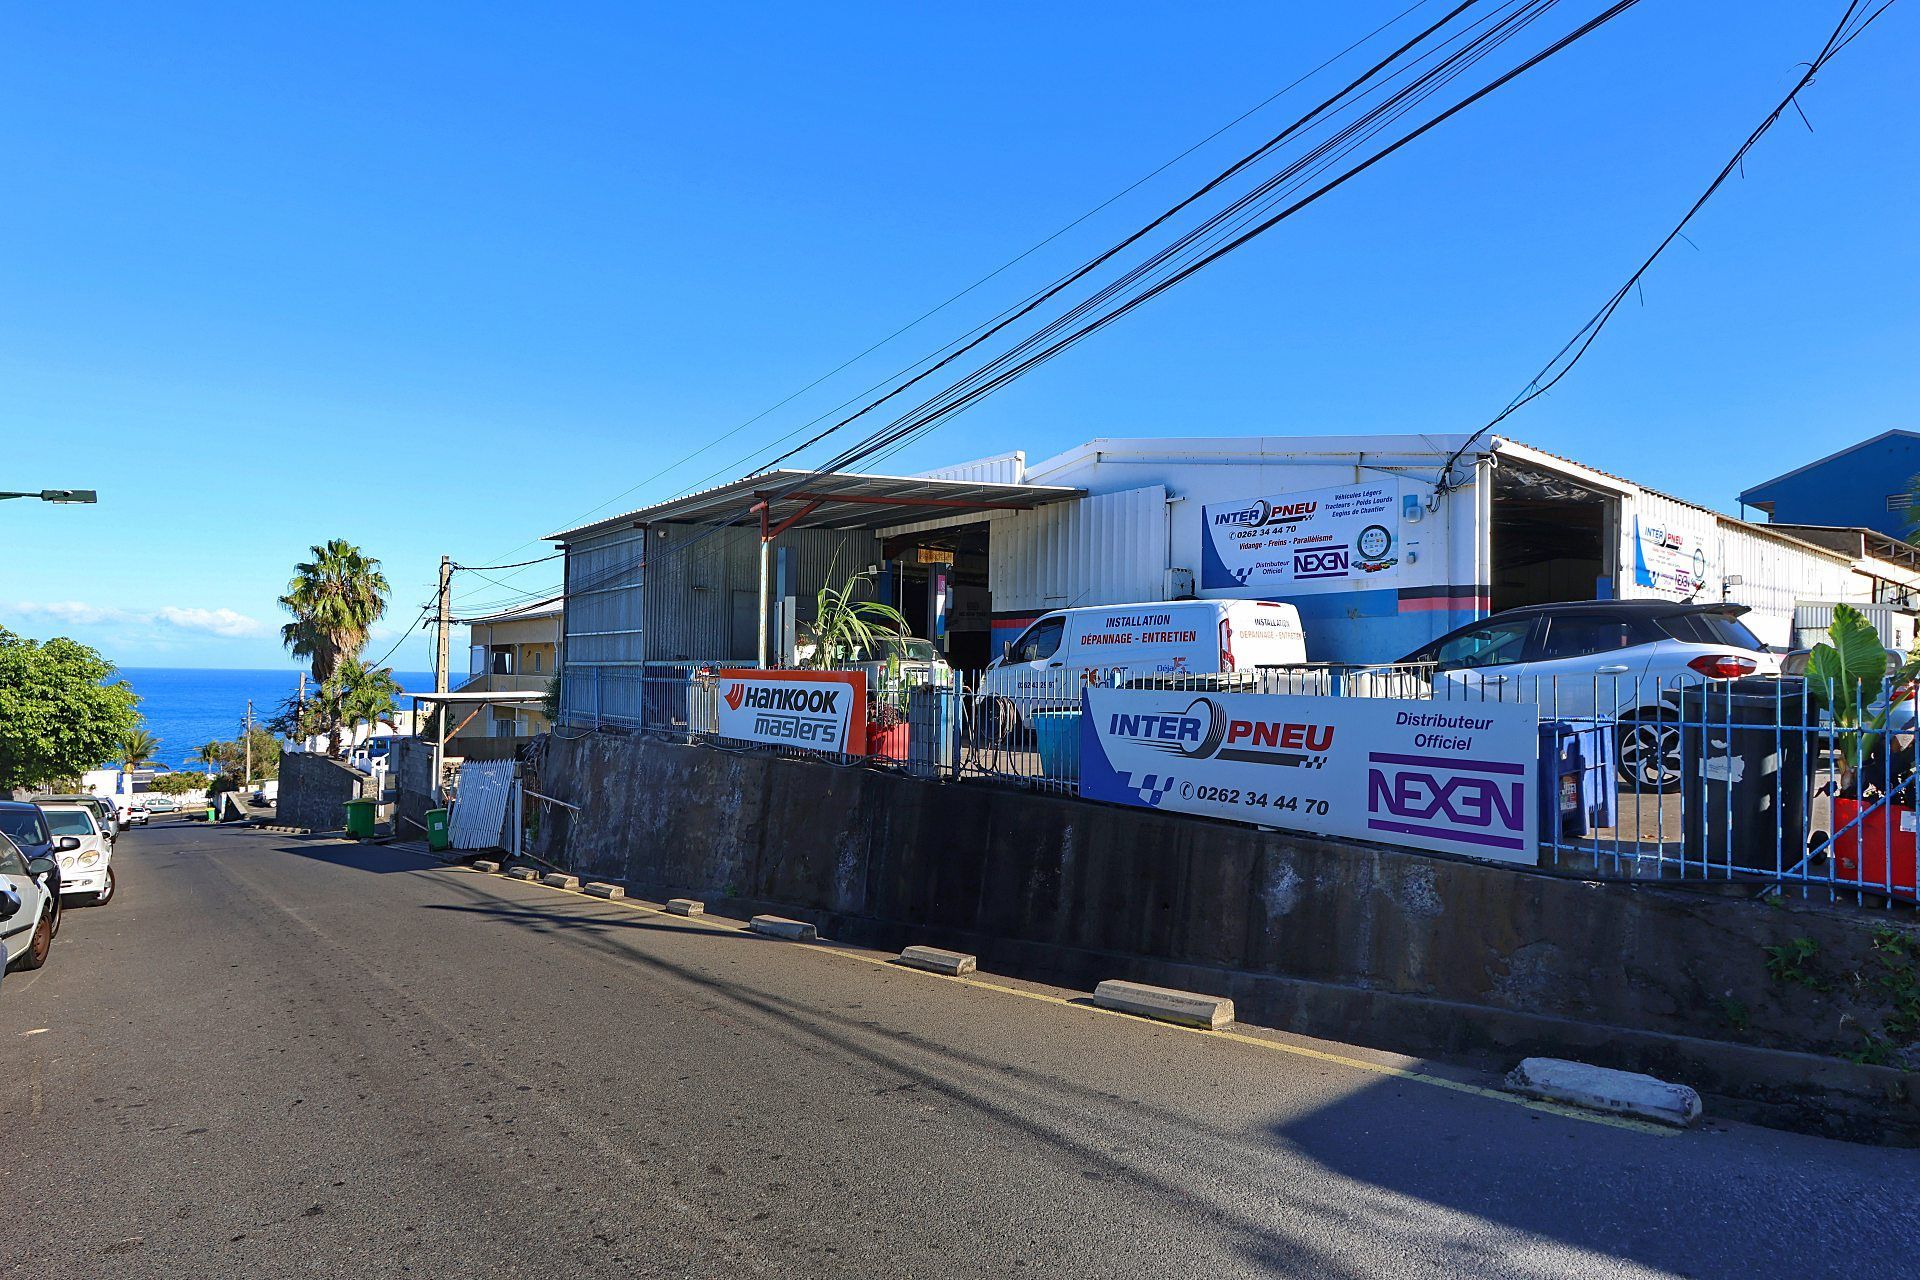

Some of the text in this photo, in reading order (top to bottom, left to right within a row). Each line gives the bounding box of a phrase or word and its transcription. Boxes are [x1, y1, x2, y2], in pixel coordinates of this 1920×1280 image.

[1335, 489, 1382, 501] Véhicules Légers
[1373, 496, 1393, 504] Lourds
[1215, 501, 1317, 525] INTER PNEU
[1332, 510, 1351, 518] Engins
[1361, 505, 1385, 514] Chantier
[1237, 530, 1257, 538] 0262
[1286, 525, 1296, 533] 70
[1645, 527, 1663, 539] INTER
[1668, 534, 1683, 545] PNEU
[1240, 542, 1262, 551] Vidange
[1268, 539, 1286, 547] Freins
[1293, 534, 1333, 544] Parallélisme
[1256, 560, 1290, 568] Distributeur
[1294, 551, 1348, 573] NEXEN
[1106, 615, 1170, 627] INSTALLATION
[1081, 633, 1132, 645] DÉPANNAGE
[1142, 631, 1196, 643] ENTRETIEN
[754, 716, 837, 743] masters
[1396, 712, 1493, 730] Distributeur
[1109, 714, 1334, 751] INTER PNEU
[1414, 734, 1472, 751] Officiel
[1197, 785, 1329, 816] 0262 34 44 70
[1368, 769, 1524, 831] NEXEN
